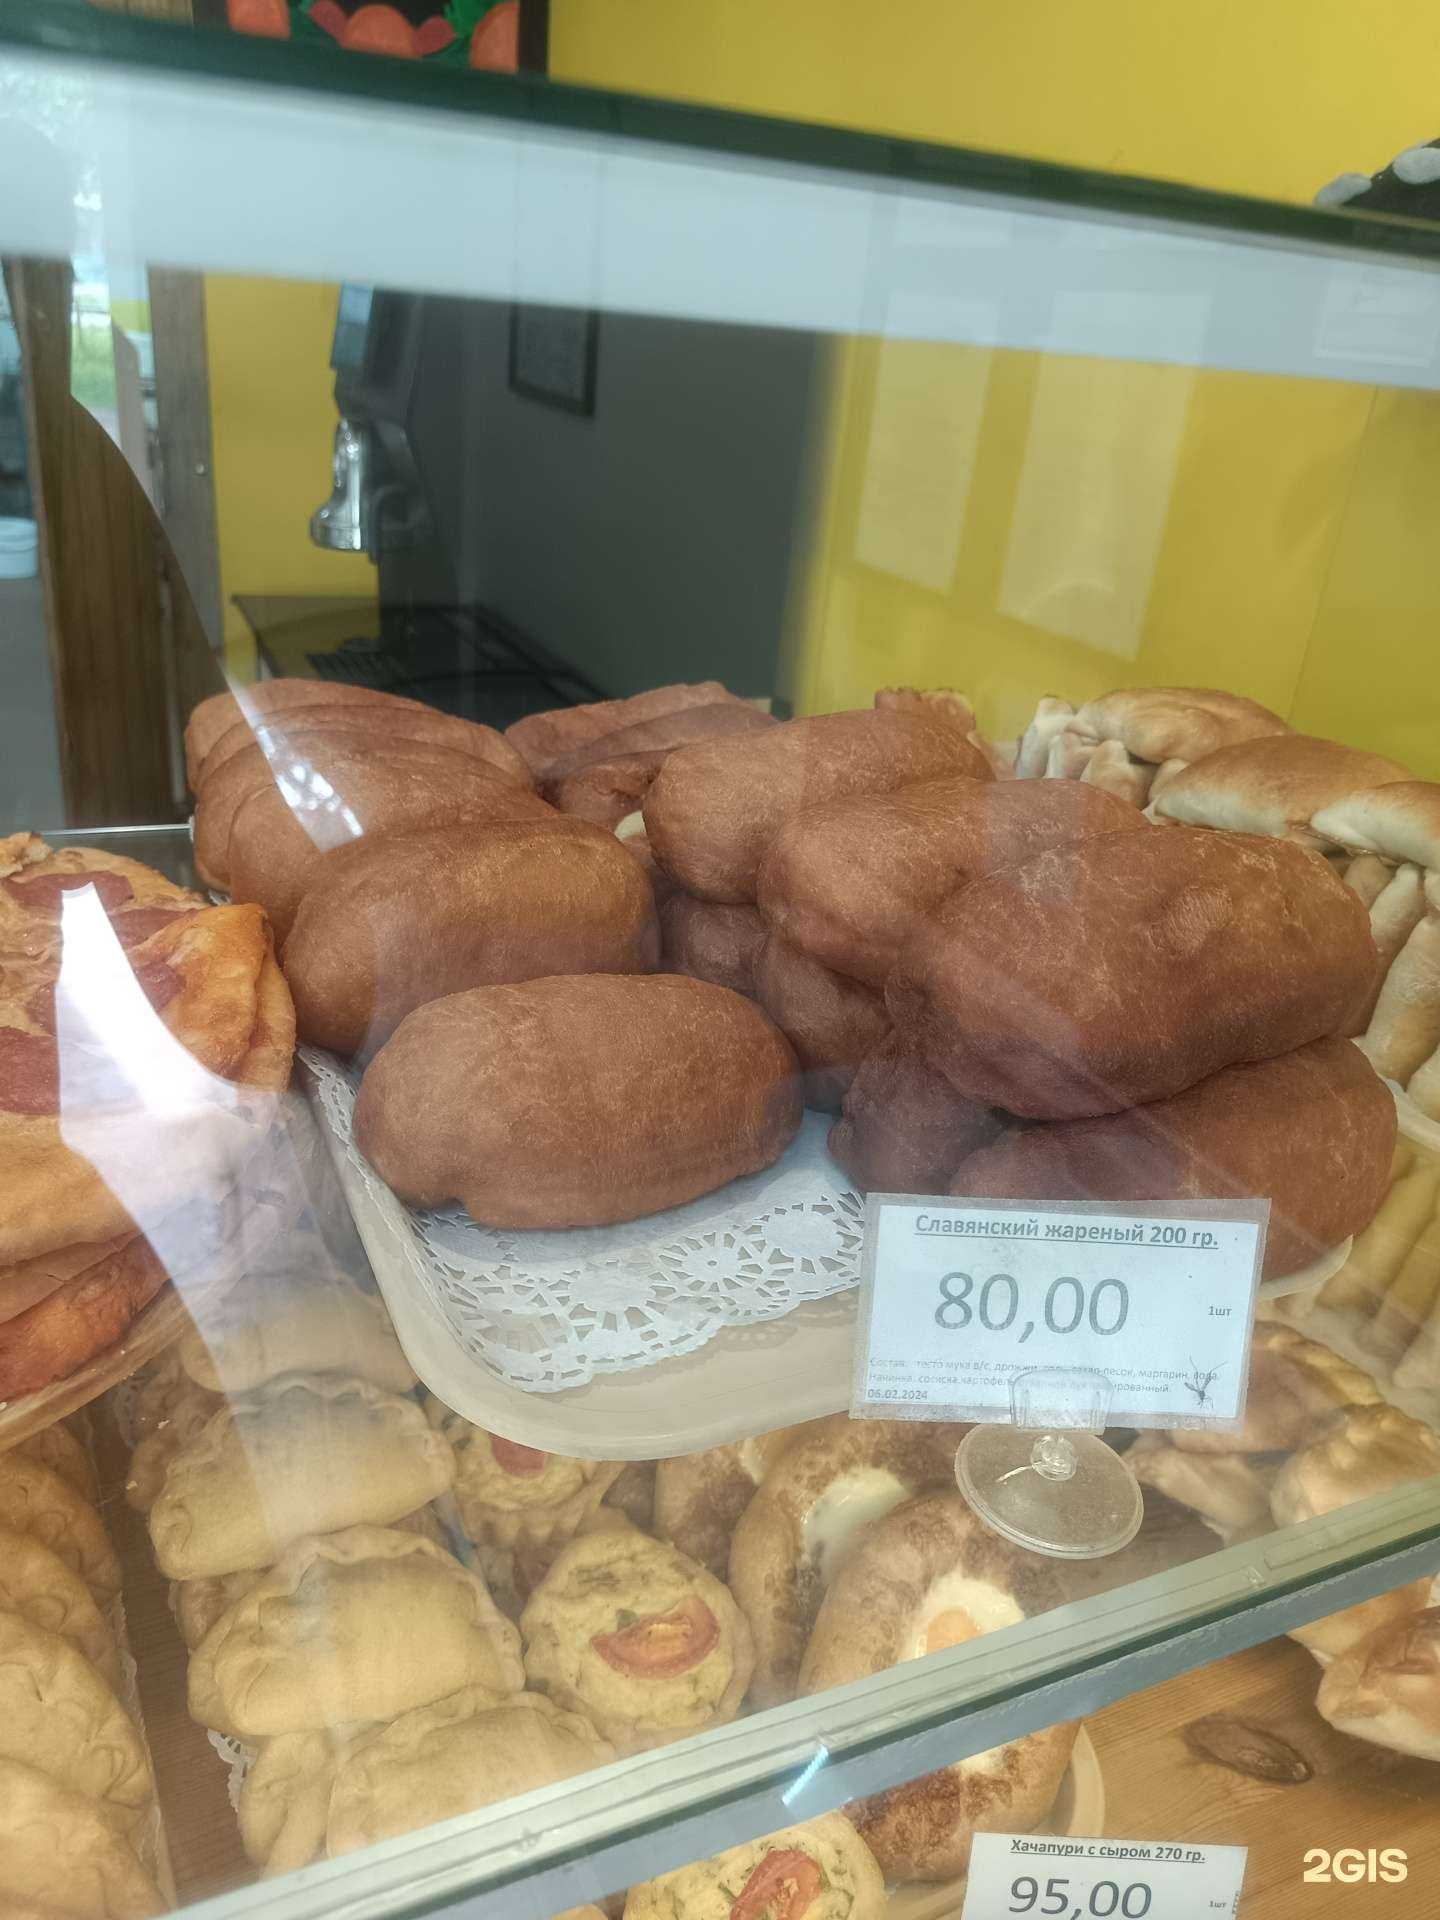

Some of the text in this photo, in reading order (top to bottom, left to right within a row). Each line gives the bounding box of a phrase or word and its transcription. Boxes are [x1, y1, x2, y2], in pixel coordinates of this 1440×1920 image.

[915, 1213, 1219, 1248] Славянский жареный 200 гр.
[933, 1271, 1130, 1344] 80,00
[1207, 1303, 1233, 1318] 1шт
[1011, 1839, 1206, 1862] Хачапури с сыром 270 гр.
[1008, 1876, 1152, 1920] 95,00
